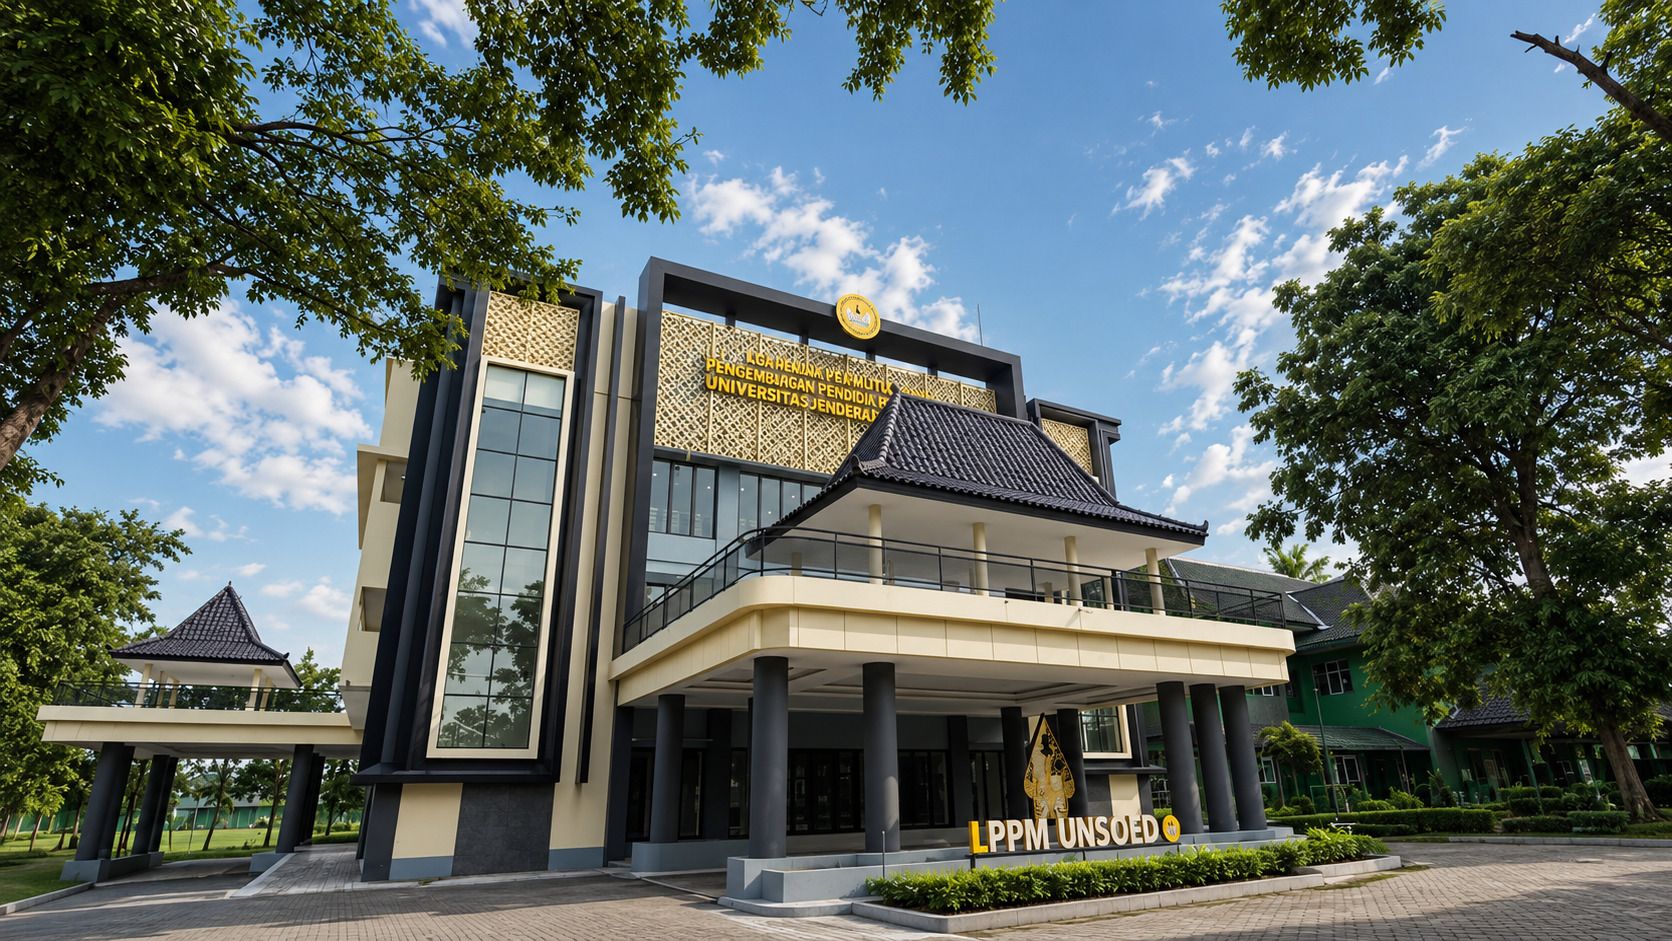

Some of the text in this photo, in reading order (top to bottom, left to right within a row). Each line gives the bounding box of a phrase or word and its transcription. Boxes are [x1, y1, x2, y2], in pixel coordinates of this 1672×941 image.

[706, 373, 809, 408] UNIVERSITAS
[969, 814, 1160, 854] LPPM UNSOED
